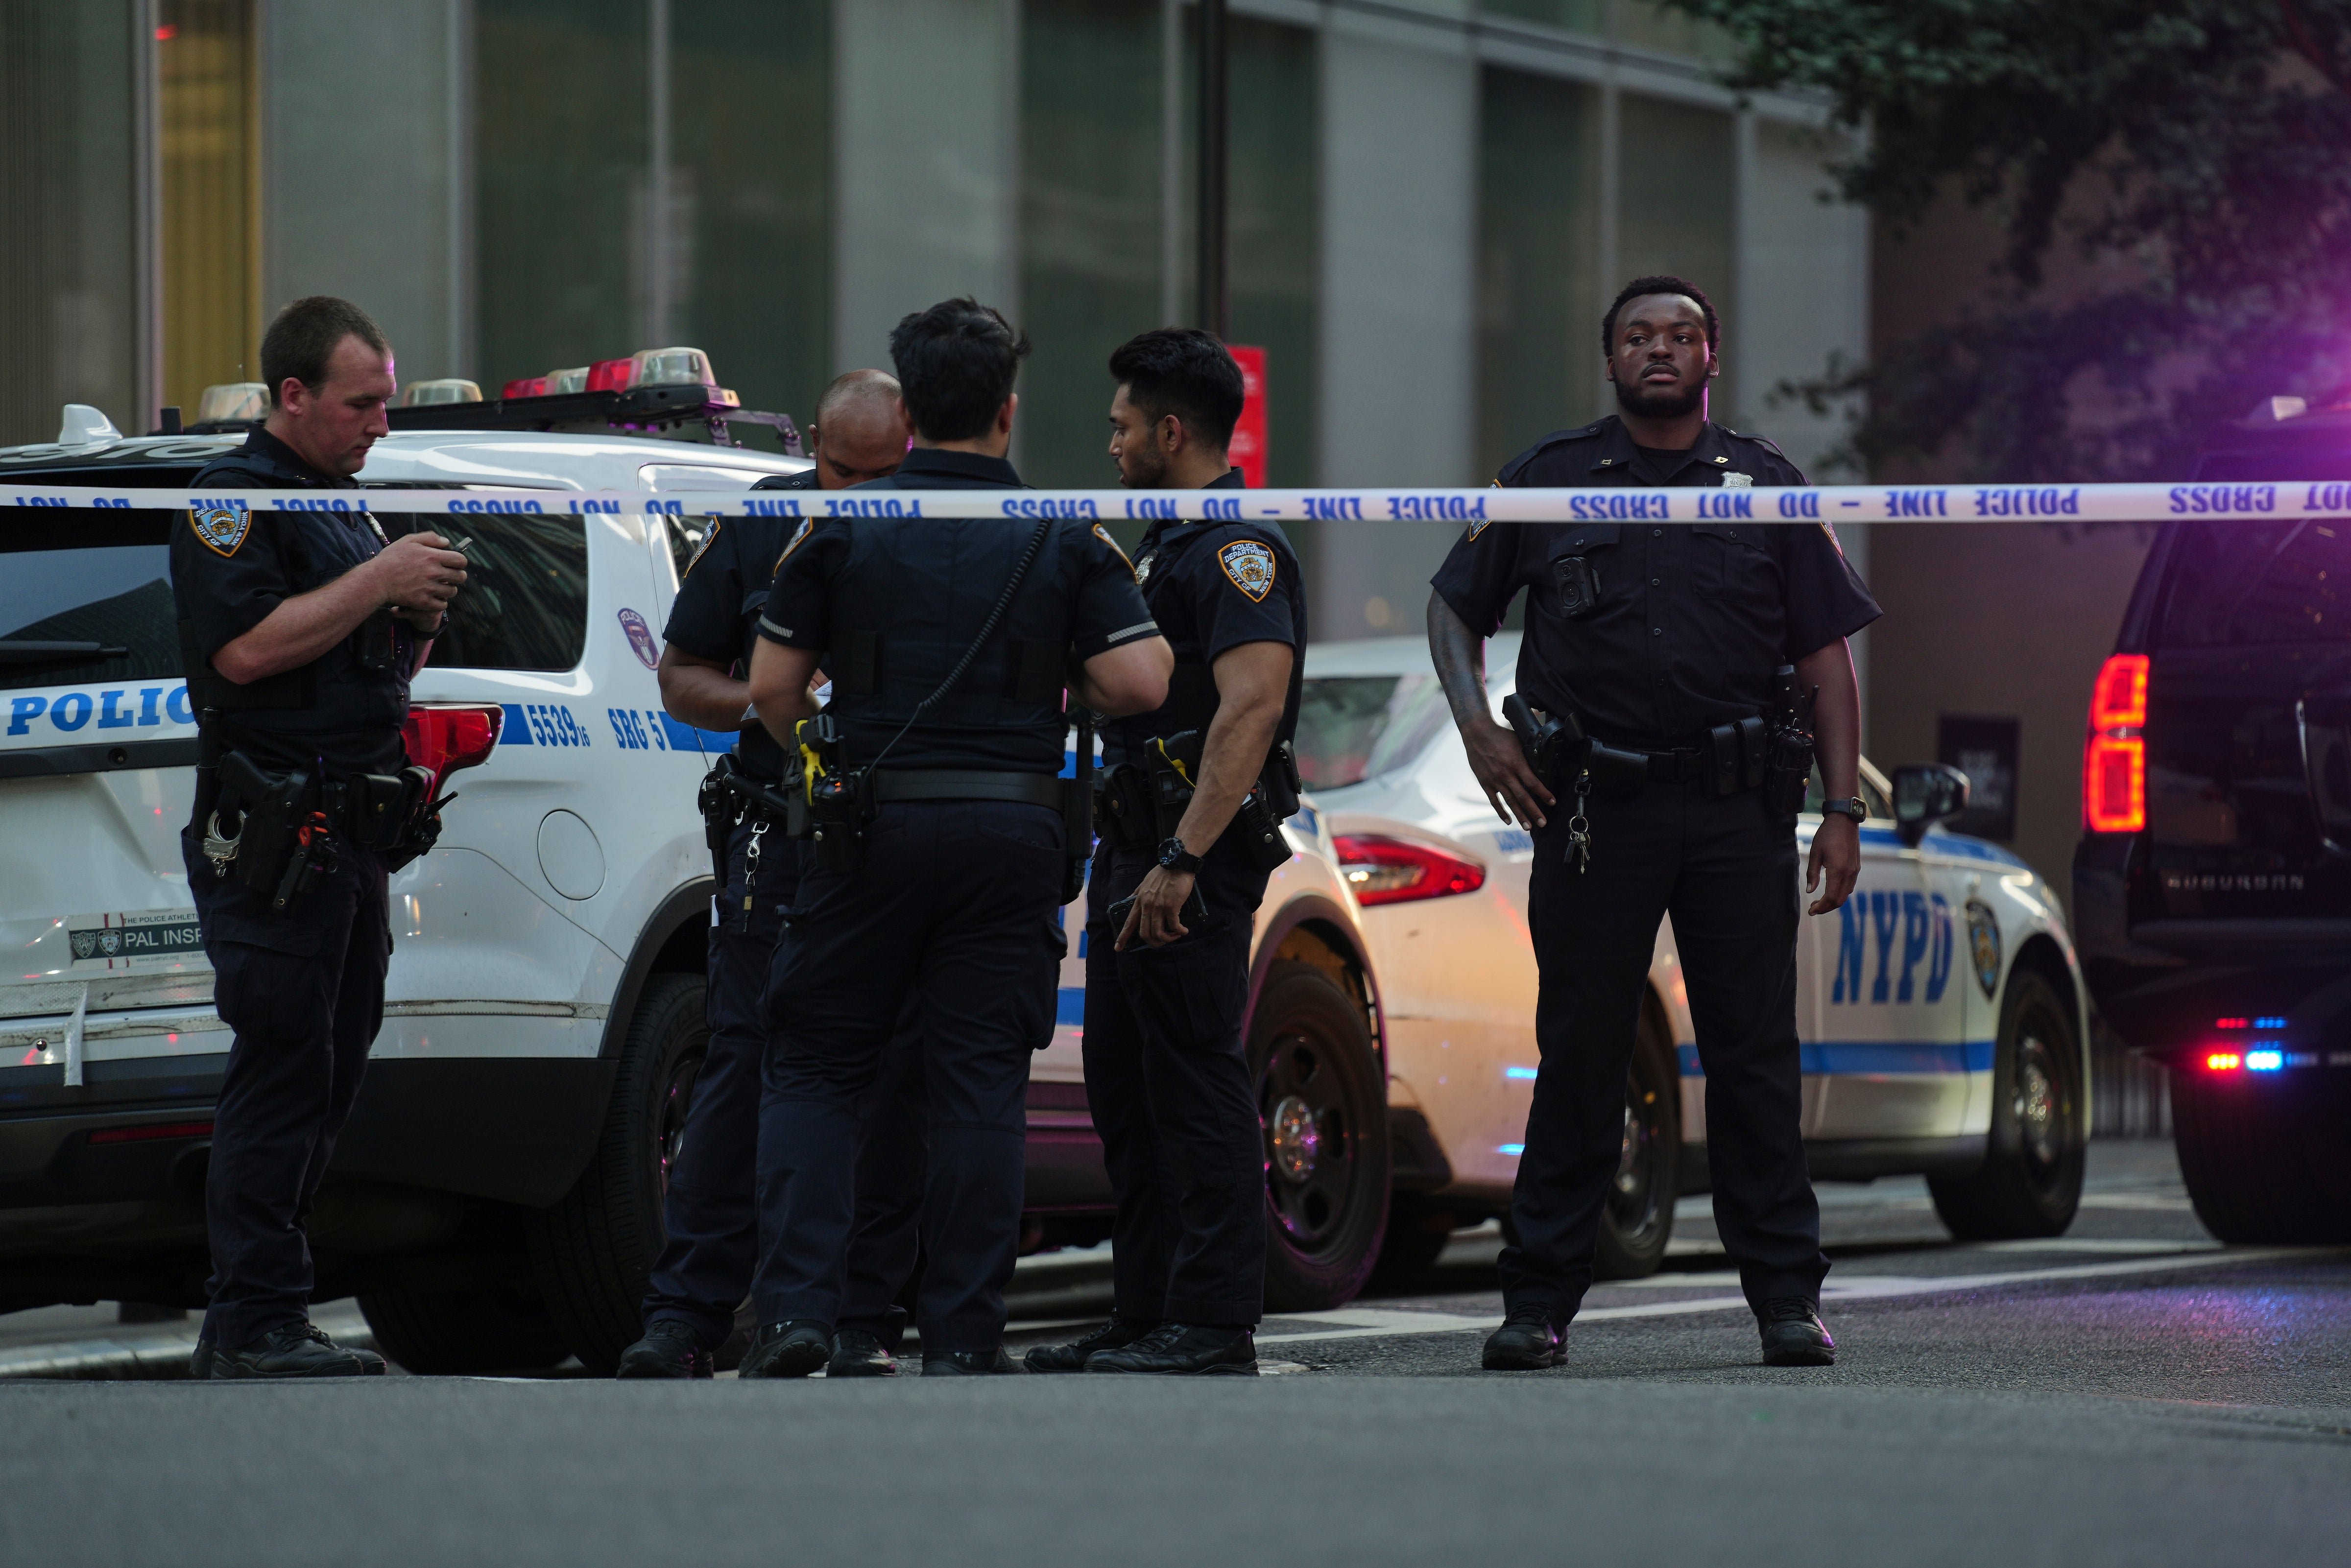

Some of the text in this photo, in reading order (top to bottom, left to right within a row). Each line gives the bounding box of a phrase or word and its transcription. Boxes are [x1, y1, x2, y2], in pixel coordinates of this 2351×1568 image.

[743, 499, 800, 517] LINE
[825, 499, 921, 517] POLICE
[1002, 499, 1097, 518] CROSS
[1126, 499, 1177, 518] NOT
[1203, 499, 1241, 519] DO
[1302, 498, 1363, 519] LINE
[1387, 497, 1486, 520] POLICE
[1569, 495, 1669, 519] CROSS
[1697, 493, 1752, 518] NOT
[1779, 492, 1820, 517] DO
[1886, 490, 1947, 517] LINE
[1975, 488, 2080, 516] POLICE
[2169, 486, 2277, 513] CROSS
[197, 511, 248, 546] CITY OF NEW YORK
[1225, 548, 1269, 563] DEPARTMENT
[1232, 543, 1258, 551] POLICE
[1229, 569, 1242, 582] CITY
[1241, 582, 1251, 591] OF
[1260, 580, 1270, 594] NEW
[7, 686, 195, 736] POLIC
[608, 708, 666, 751] SRG 5
[124, 931, 159, 948] PAL
[1832, 890, 1954, 1005] NYPD
